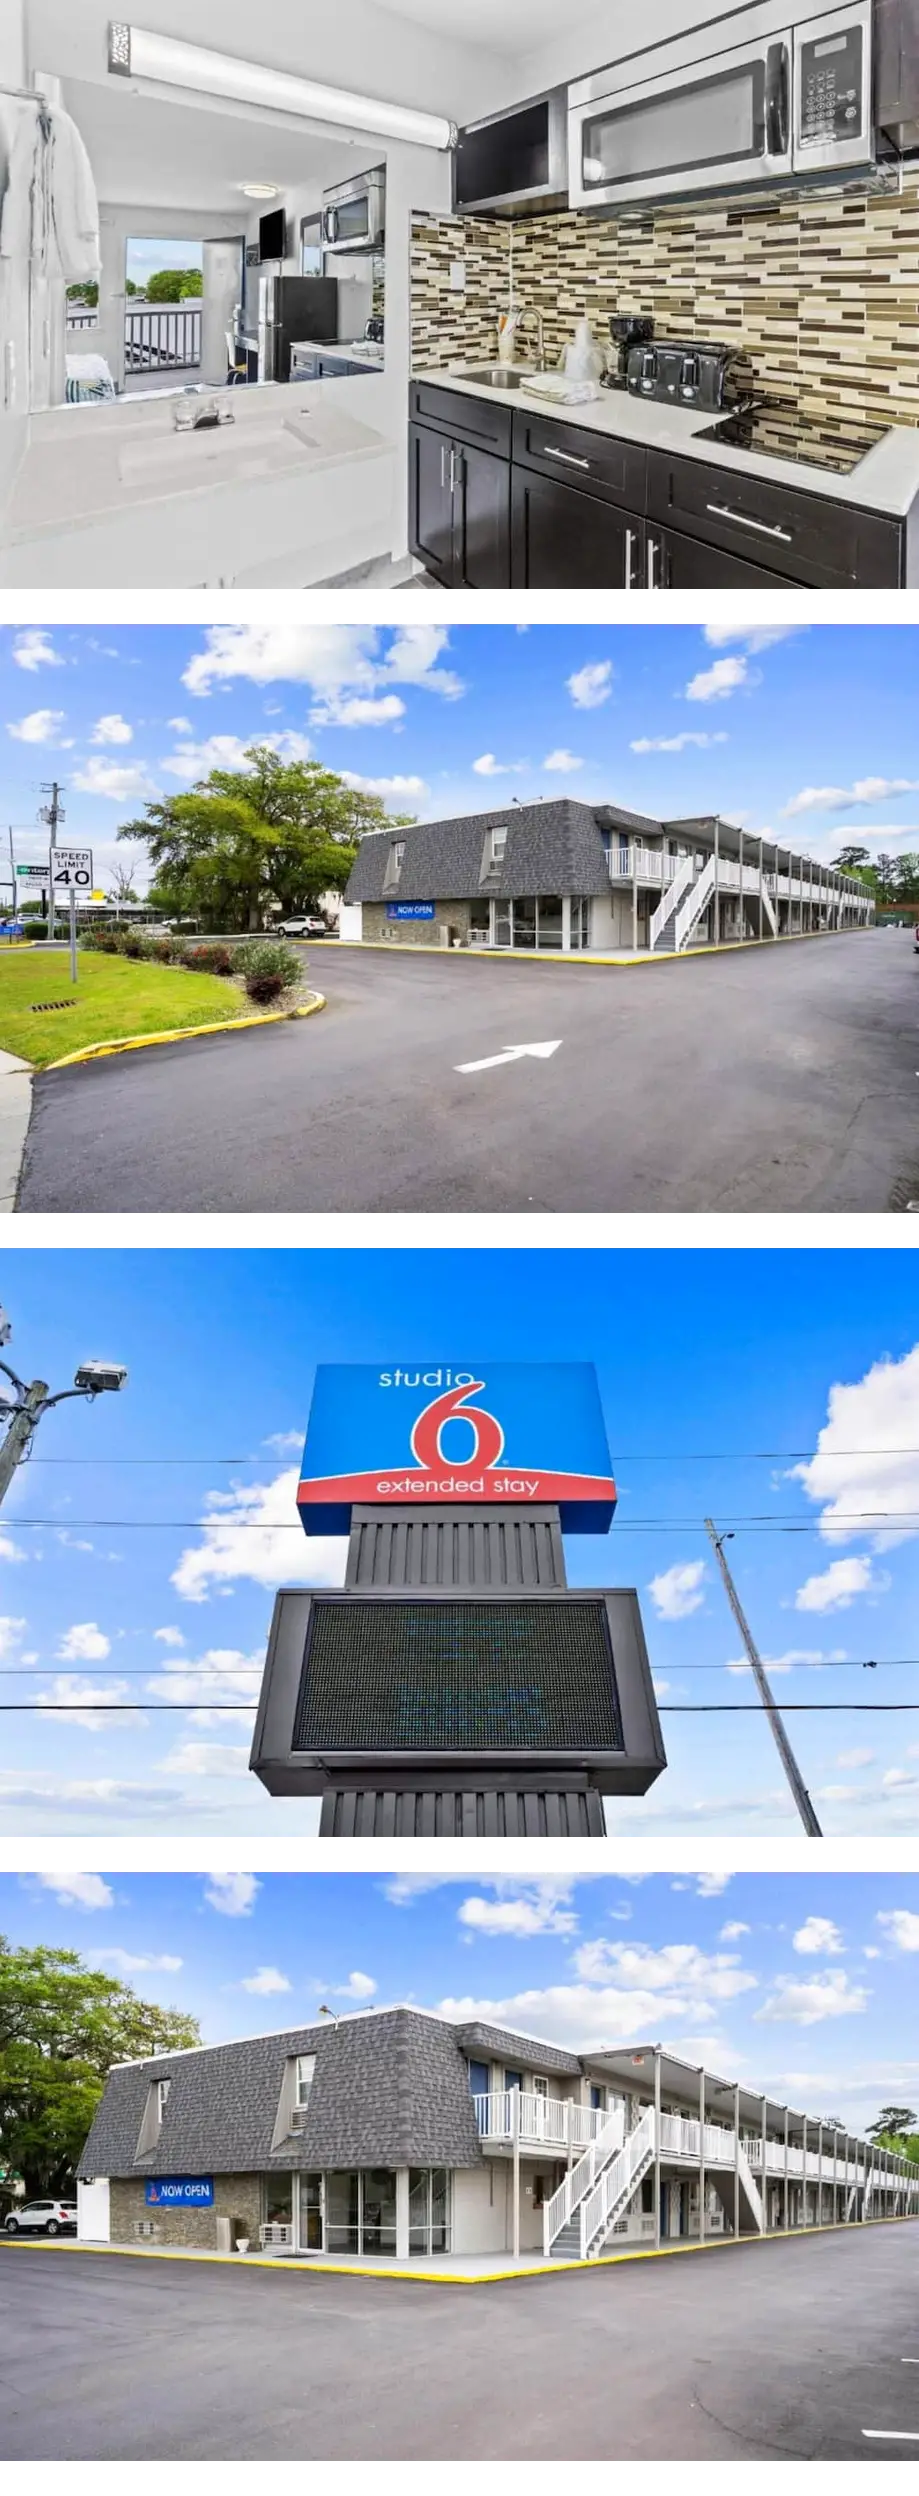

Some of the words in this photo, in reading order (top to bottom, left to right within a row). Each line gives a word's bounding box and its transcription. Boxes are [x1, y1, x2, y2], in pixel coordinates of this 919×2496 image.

[54, 852, 89, 860] SPEED
[54, 870, 90, 885] 40
[397, 906, 413, 914] NOW
[414, 905, 433, 914] OPEN
[379, 1369, 475, 1387] studio
[410, 1381, 505, 1470] 6
[376, 1476, 484, 1494] extended
[493, 1477, 540, 1496] stay
[161, 2185, 183, 2197] NOW
[184, 2184, 210, 2197] OPEN
